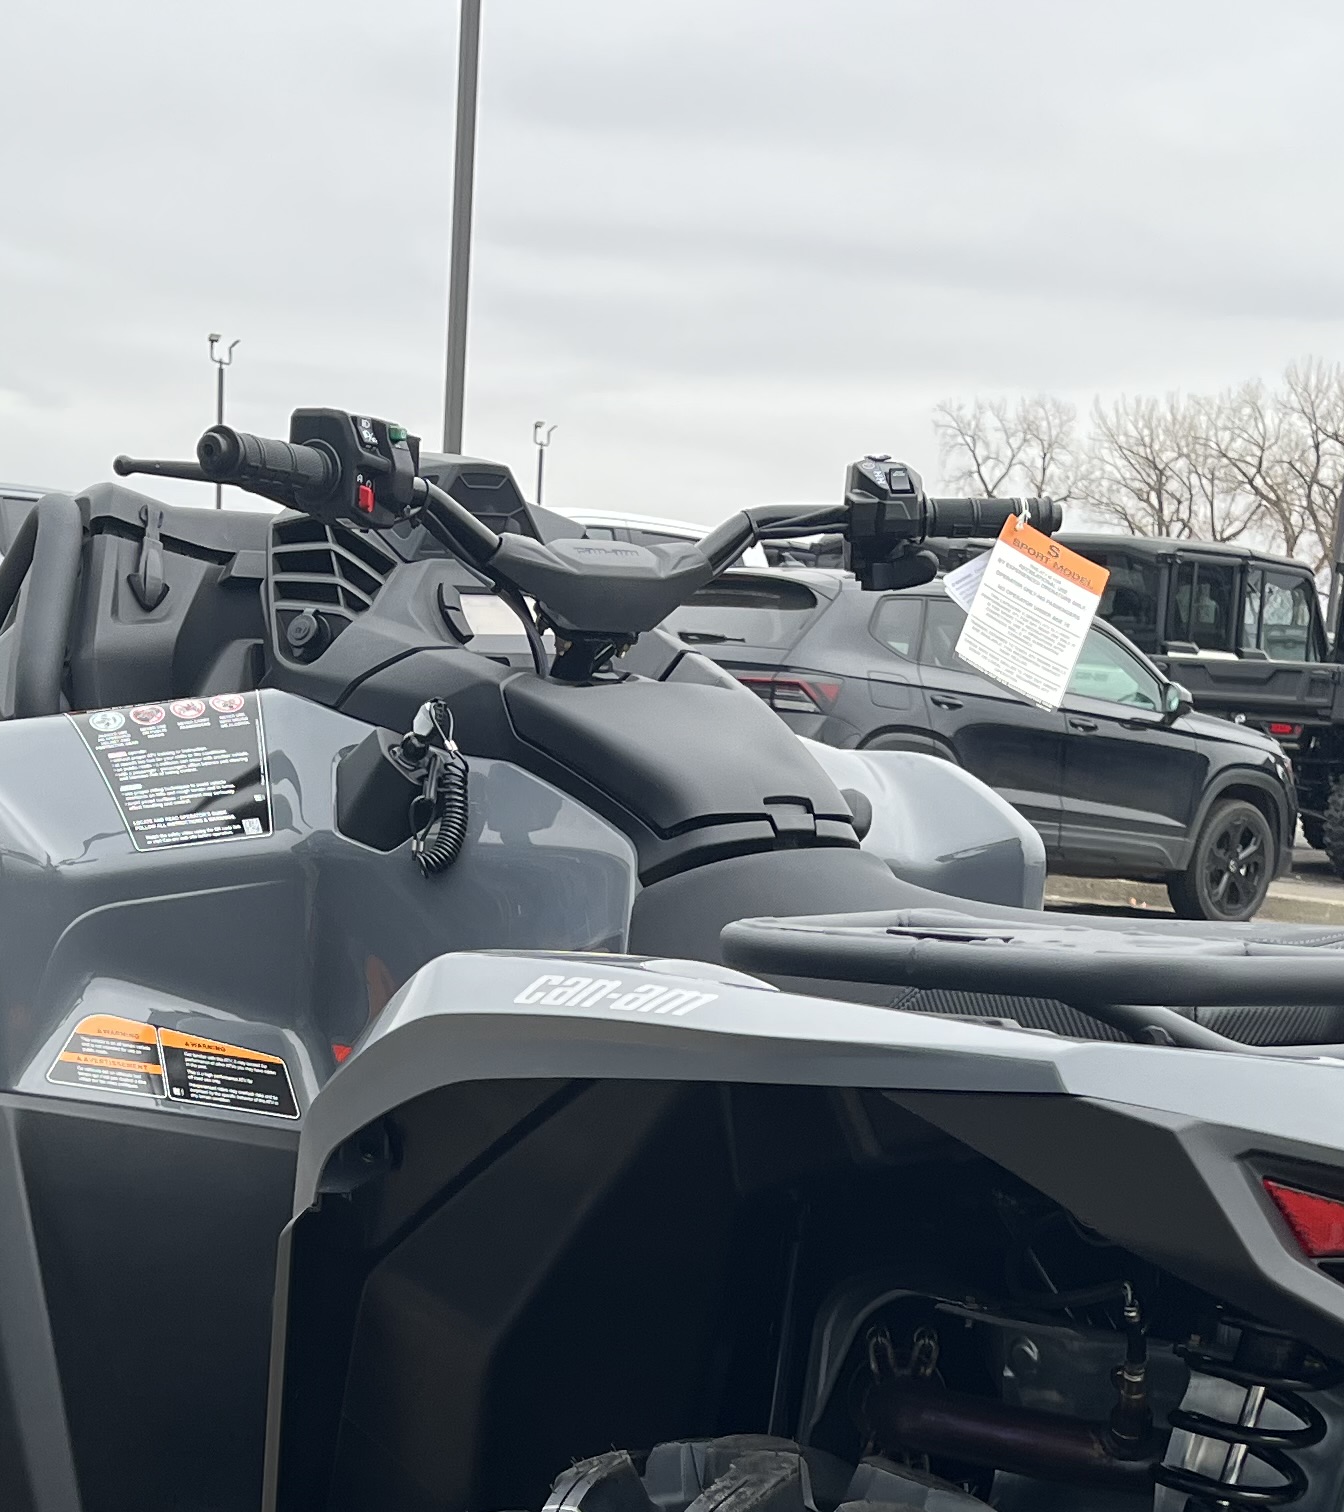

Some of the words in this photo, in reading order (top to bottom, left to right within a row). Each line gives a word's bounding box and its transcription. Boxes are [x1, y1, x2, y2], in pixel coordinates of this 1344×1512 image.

[1012, 538, 1050, 565] SPORT
[1053, 561, 1095, 590] MODEL
[1047, 544, 1061, 559] S
[513, 975, 719, 1016] can-am
[189, 1042, 227, 1052] WARNING
